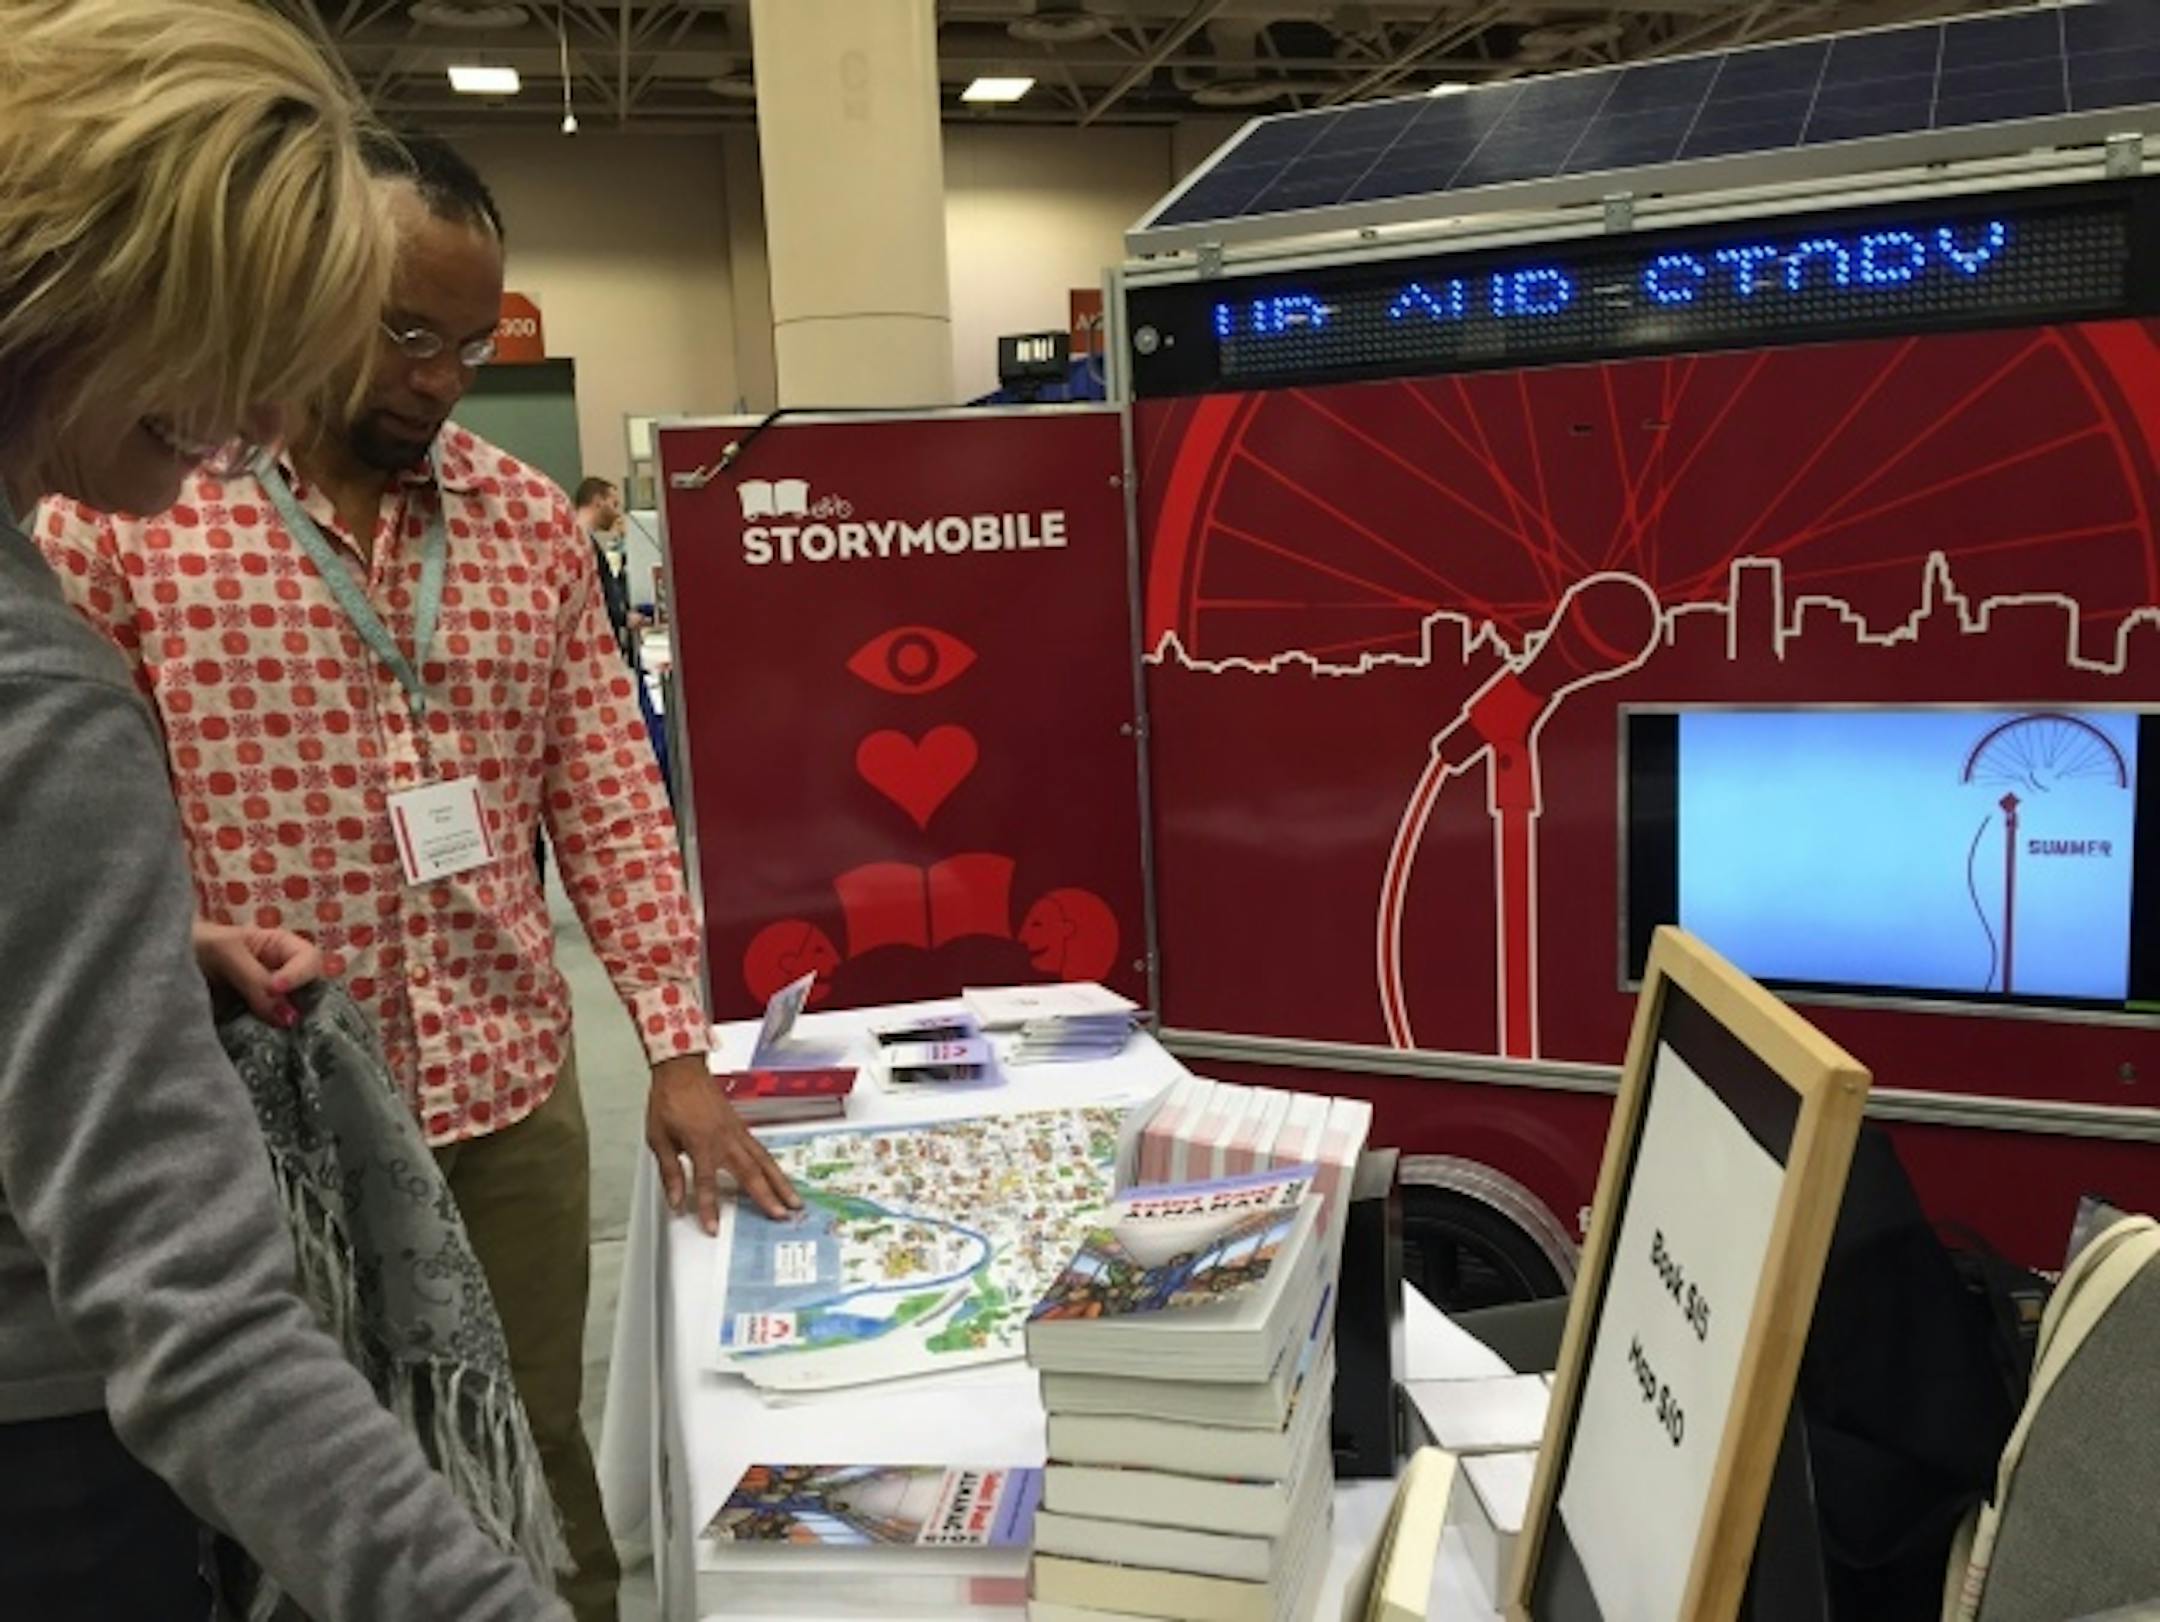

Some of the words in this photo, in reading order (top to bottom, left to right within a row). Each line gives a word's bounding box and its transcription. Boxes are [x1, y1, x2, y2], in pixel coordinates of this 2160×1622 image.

[742, 510, 1068, 565] STORYMOBILE
[2027, 839, 2113, 858] SUMMER
[1650, 1227, 1684, 1305] Book
[1685, 1283, 1711, 1342] $15
[1628, 1332, 1657, 1403] Map
[1657, 1384, 1684, 1447] $10
